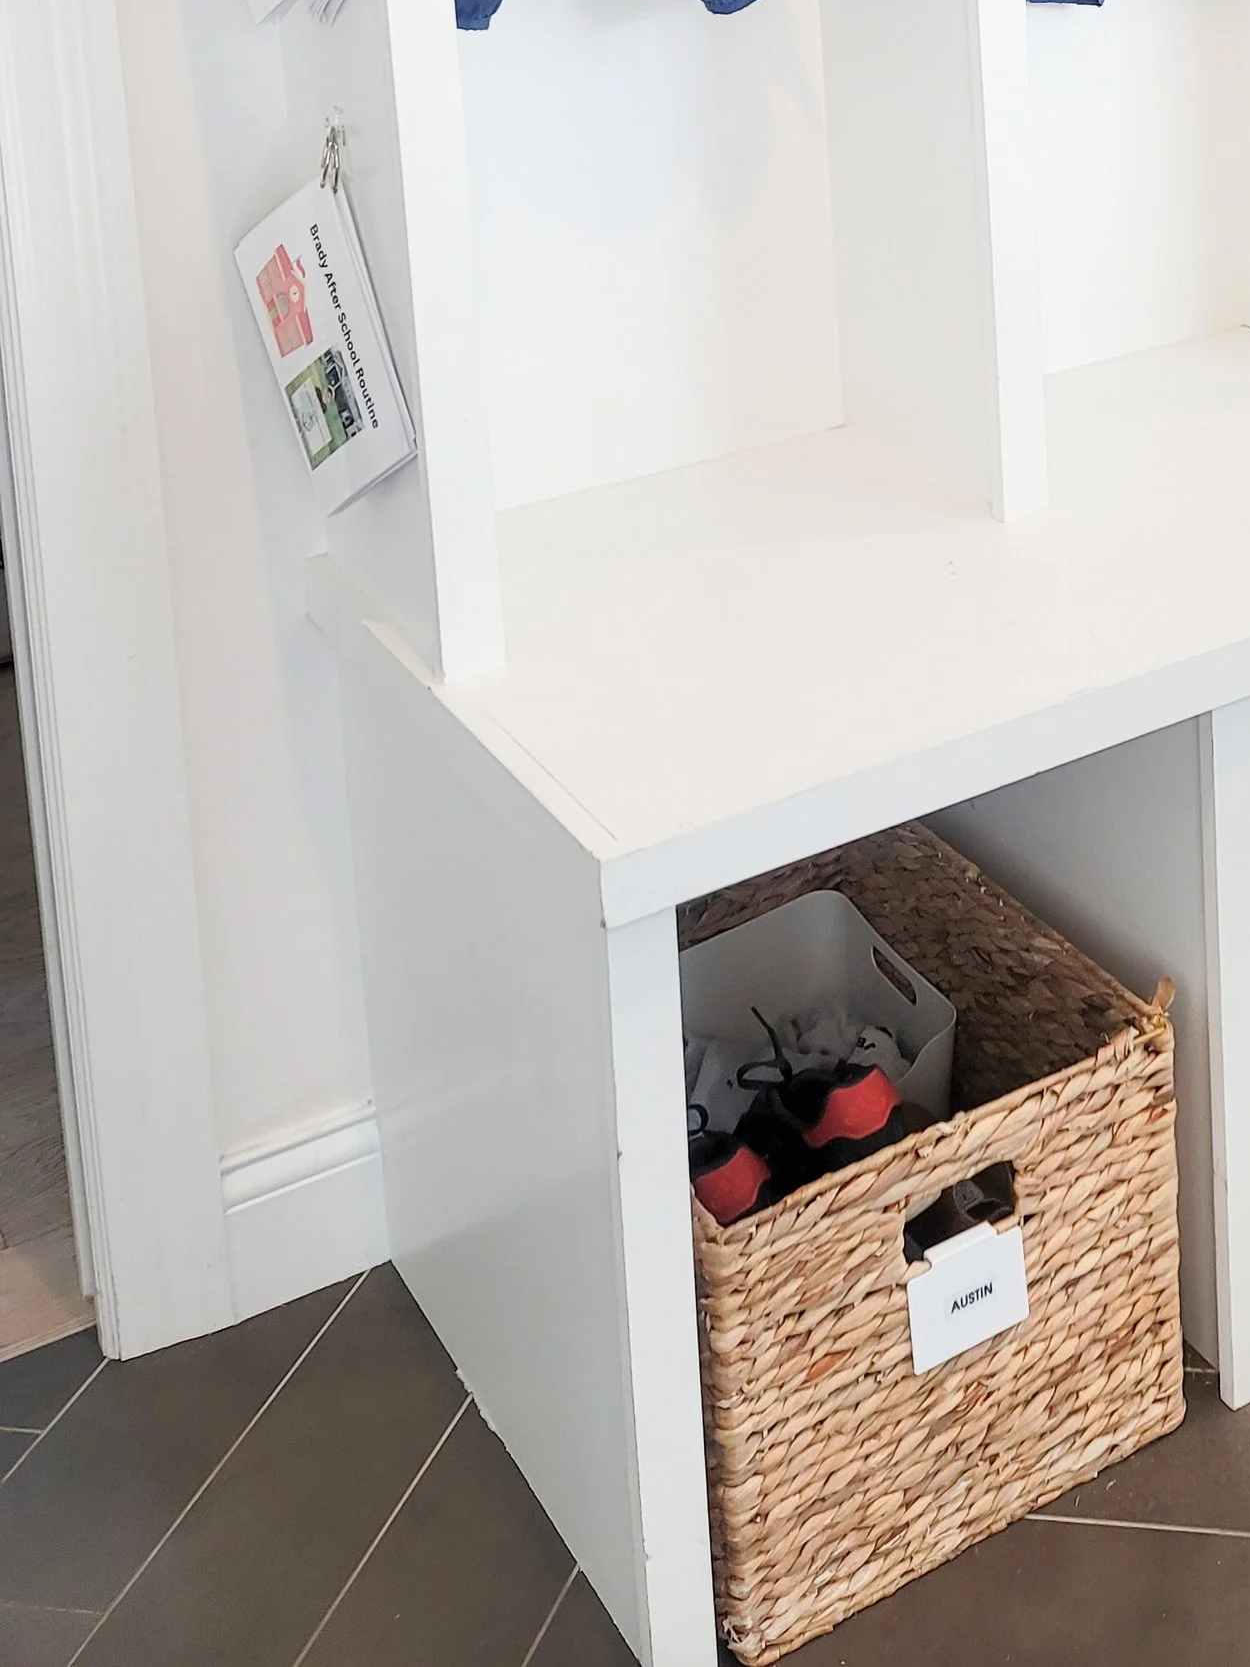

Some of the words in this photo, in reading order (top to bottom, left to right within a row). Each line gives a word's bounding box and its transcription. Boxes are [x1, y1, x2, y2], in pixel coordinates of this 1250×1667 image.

[309, 223, 329, 269] Brady
[324, 272, 342, 310] After
[337, 312, 361, 368] School
[355, 367, 379, 429] Routine
[950, 1282, 994, 1315] AUSTIN
